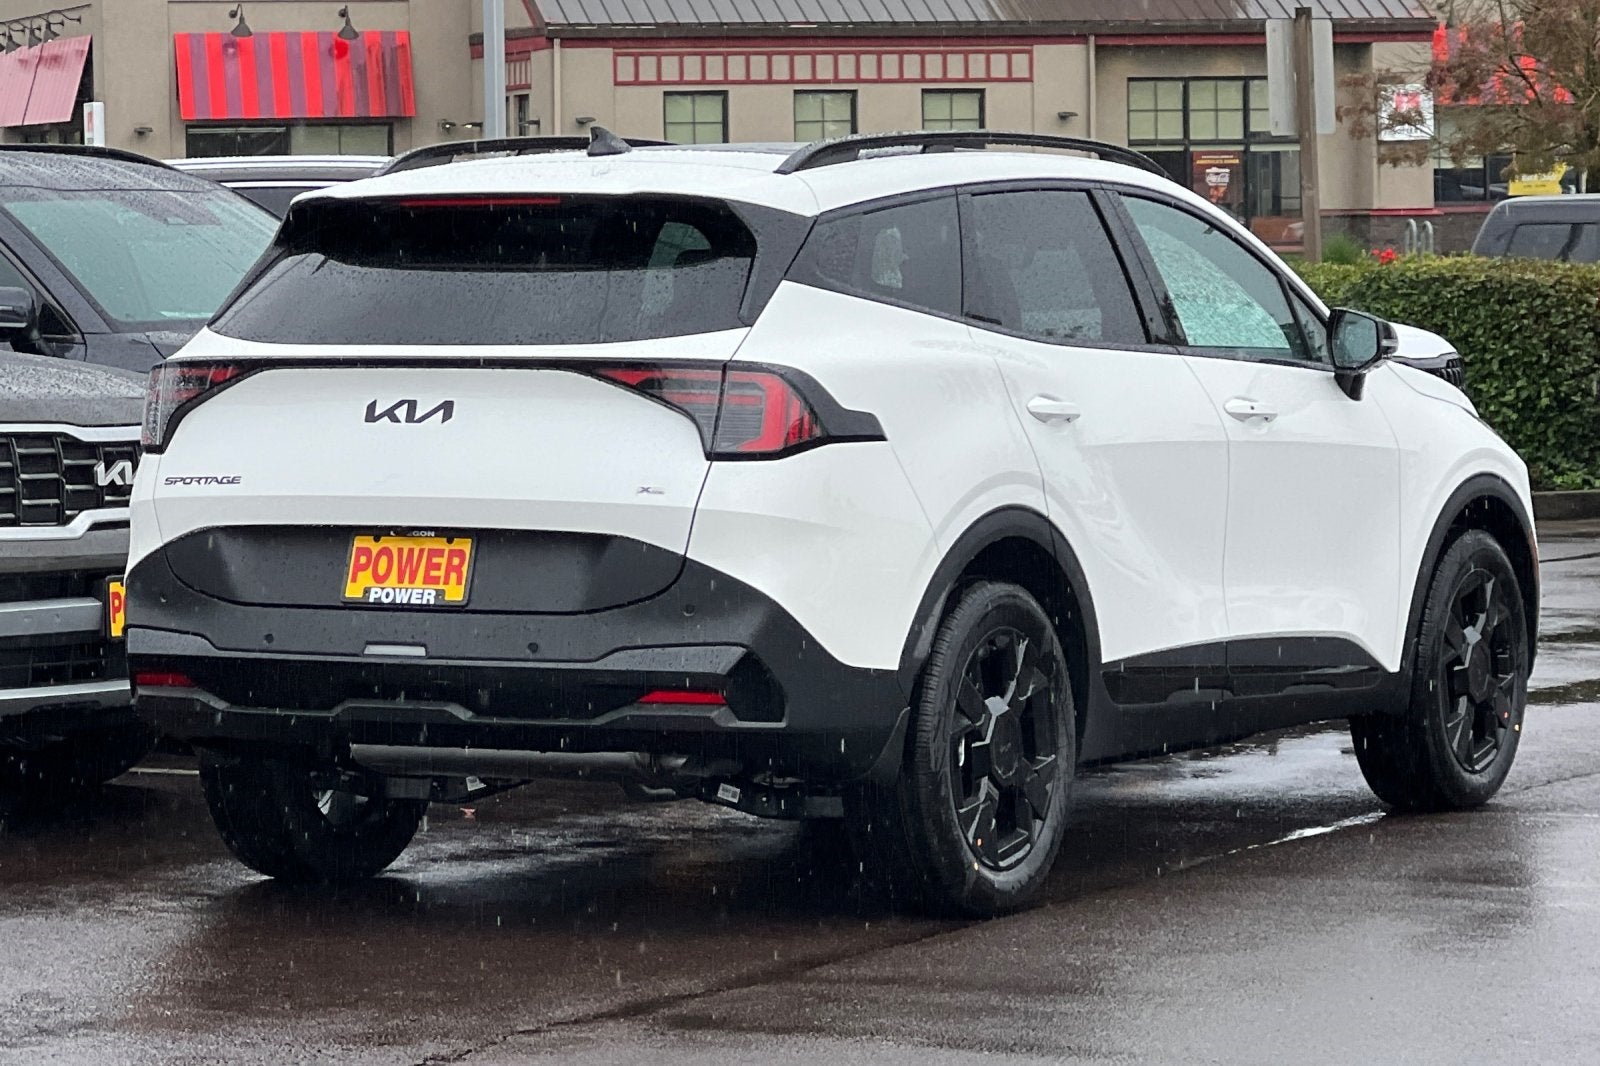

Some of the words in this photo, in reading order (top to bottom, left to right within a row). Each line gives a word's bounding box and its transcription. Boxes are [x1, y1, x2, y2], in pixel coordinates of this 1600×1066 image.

[364, 399, 455, 424] KIA
[94, 459, 135, 486] KI
[164, 475, 242, 485] SPORTAGE
[350, 546, 467, 586] POWER
[368, 587, 437, 604] POWER
